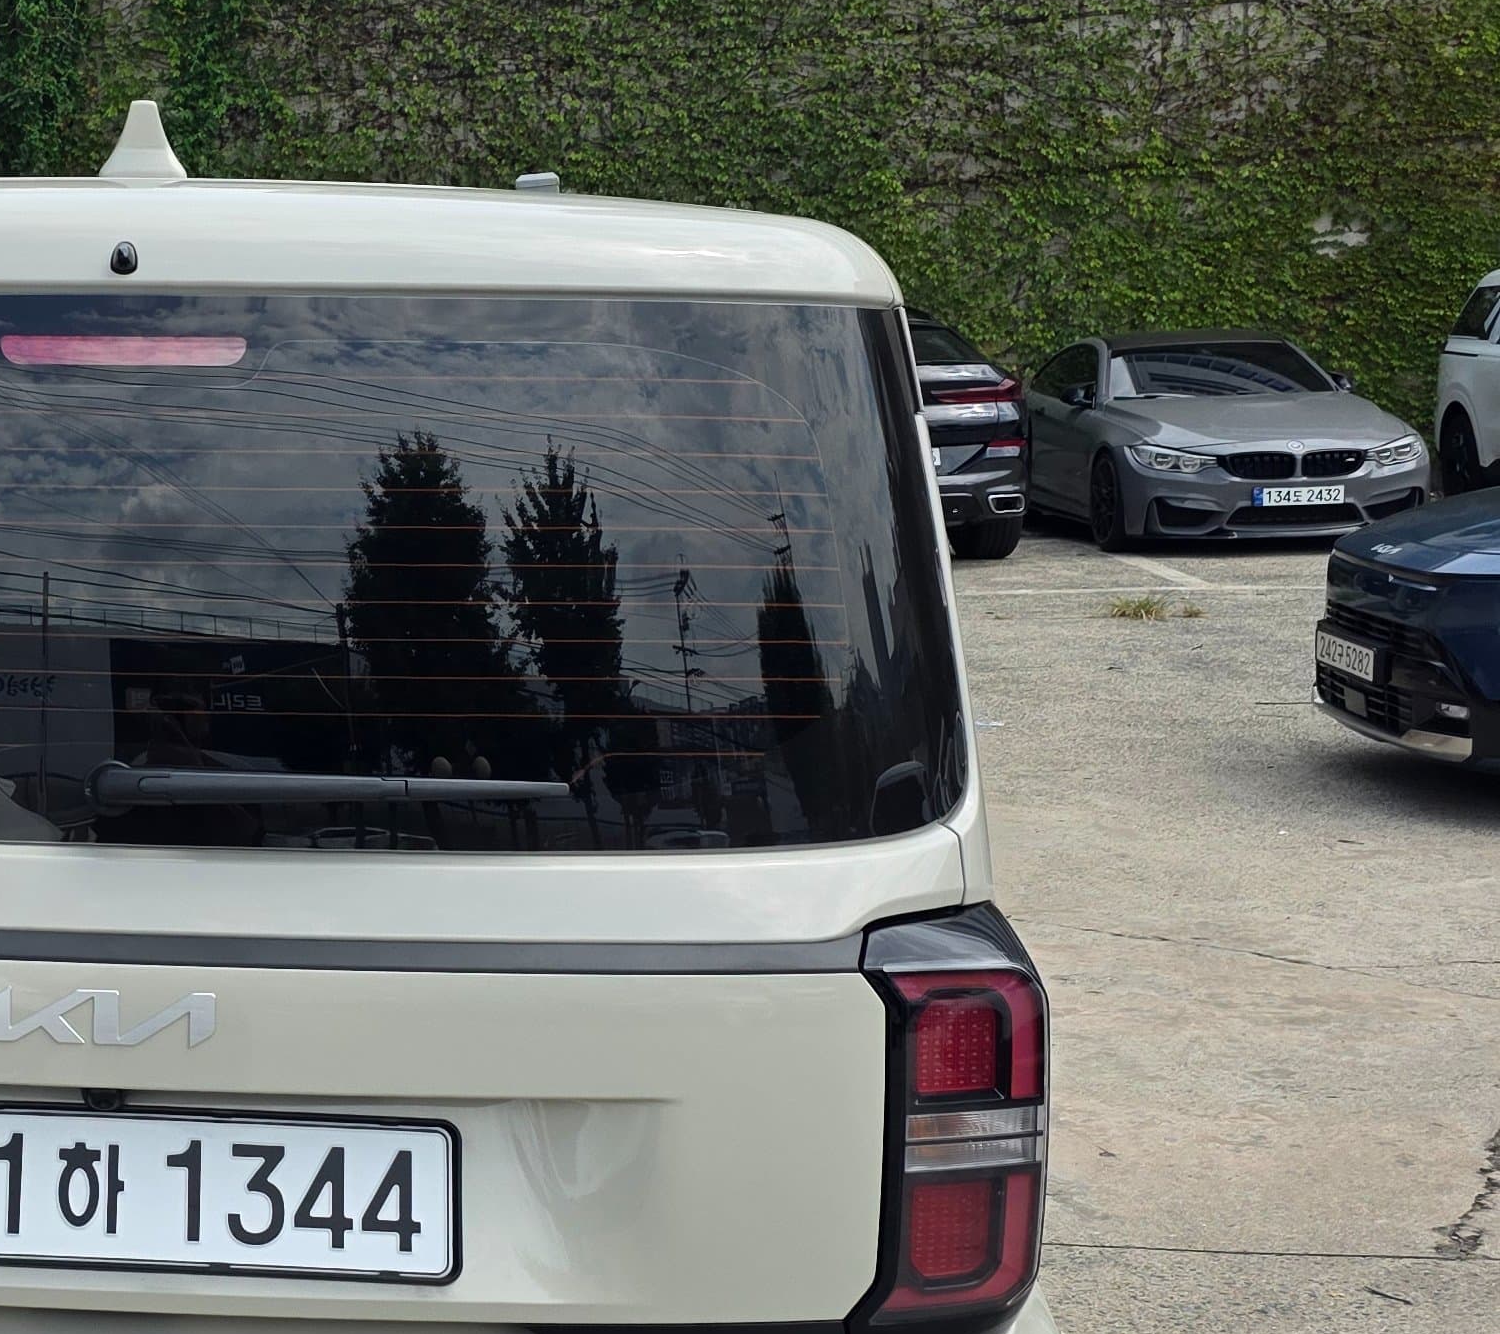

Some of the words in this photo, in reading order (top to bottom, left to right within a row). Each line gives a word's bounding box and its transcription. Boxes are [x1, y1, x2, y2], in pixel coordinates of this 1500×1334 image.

[1306, 488, 1342, 502] 2432
[1345, 645, 1371, 676] 5282
[166, 1139, 422, 1253] 1344
